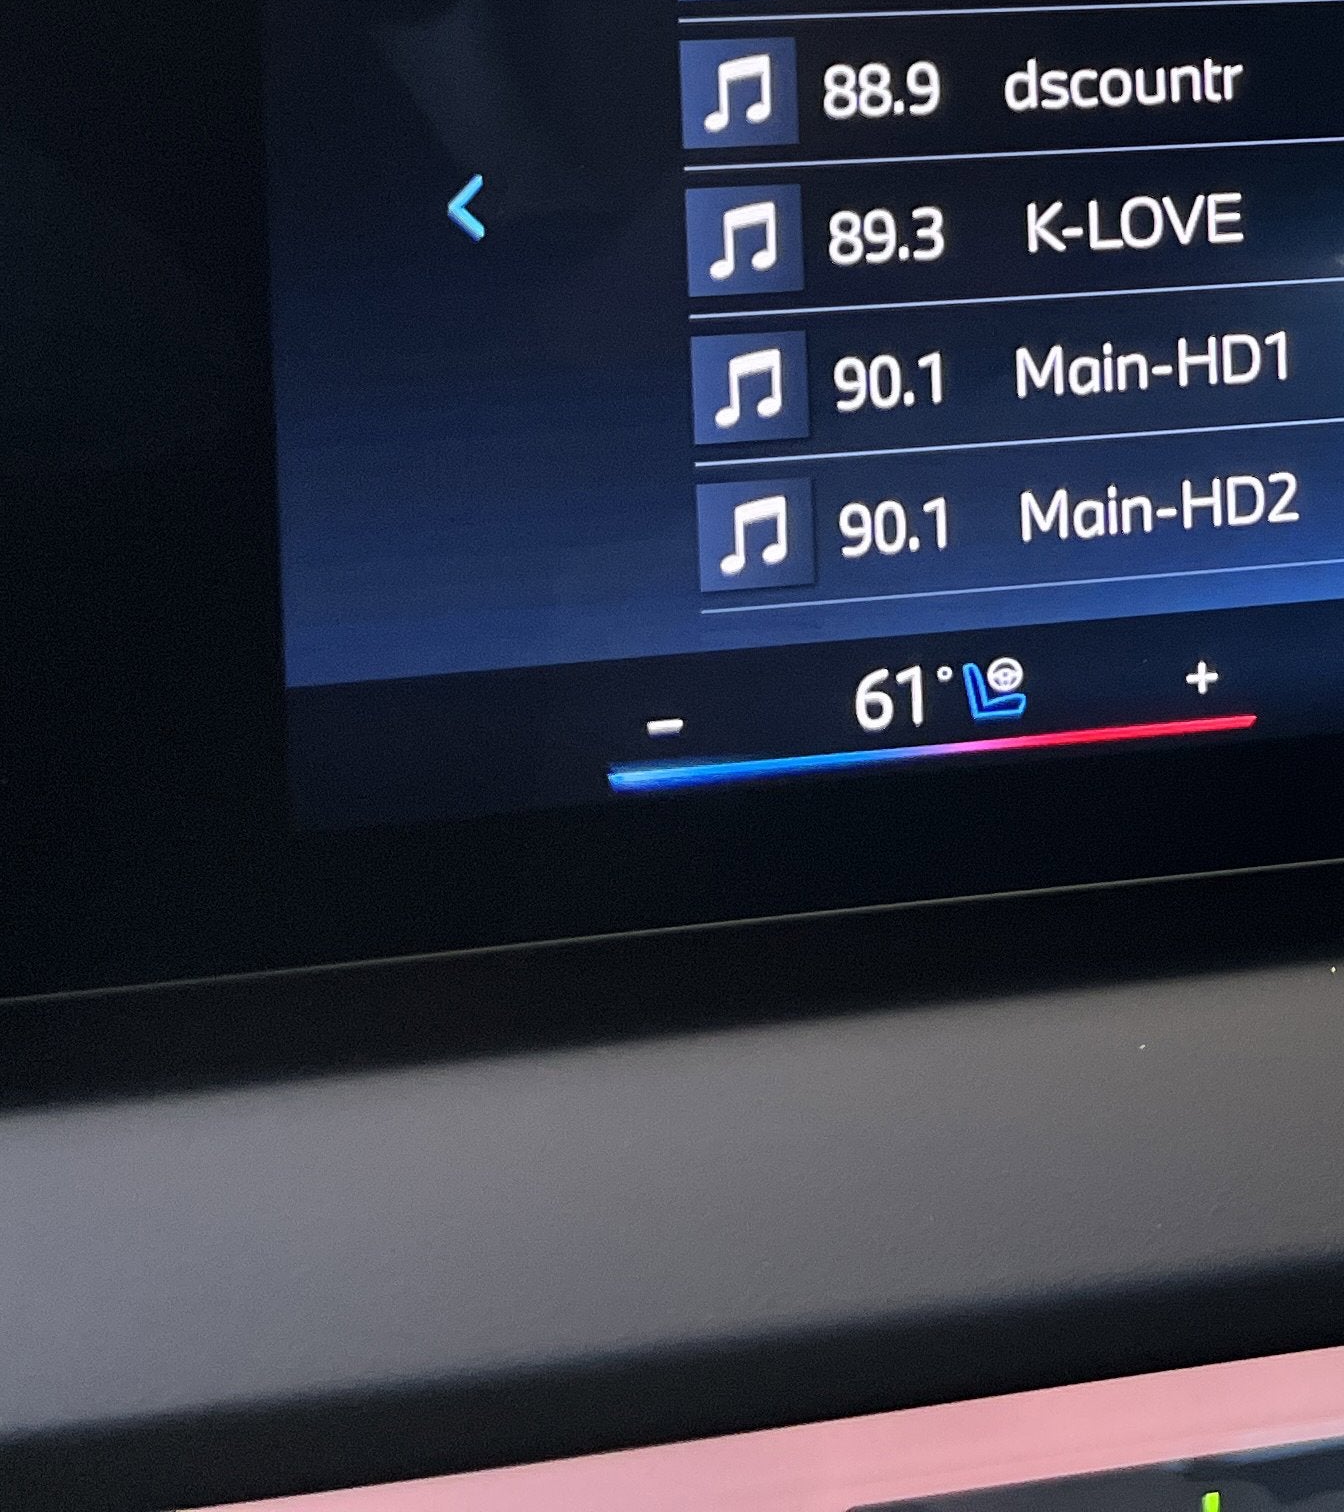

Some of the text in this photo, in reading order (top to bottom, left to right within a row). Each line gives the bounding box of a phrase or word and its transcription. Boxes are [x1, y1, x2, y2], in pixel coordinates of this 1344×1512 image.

[823, 58, 1243, 119] 88.9 dscountr
[828, 192, 1245, 265] 89.3 K-LOVE
[832, 331, 1292, 413] 90.1 Main-HD1
[838, 472, 1300, 559] 90.1 Main-HD2
